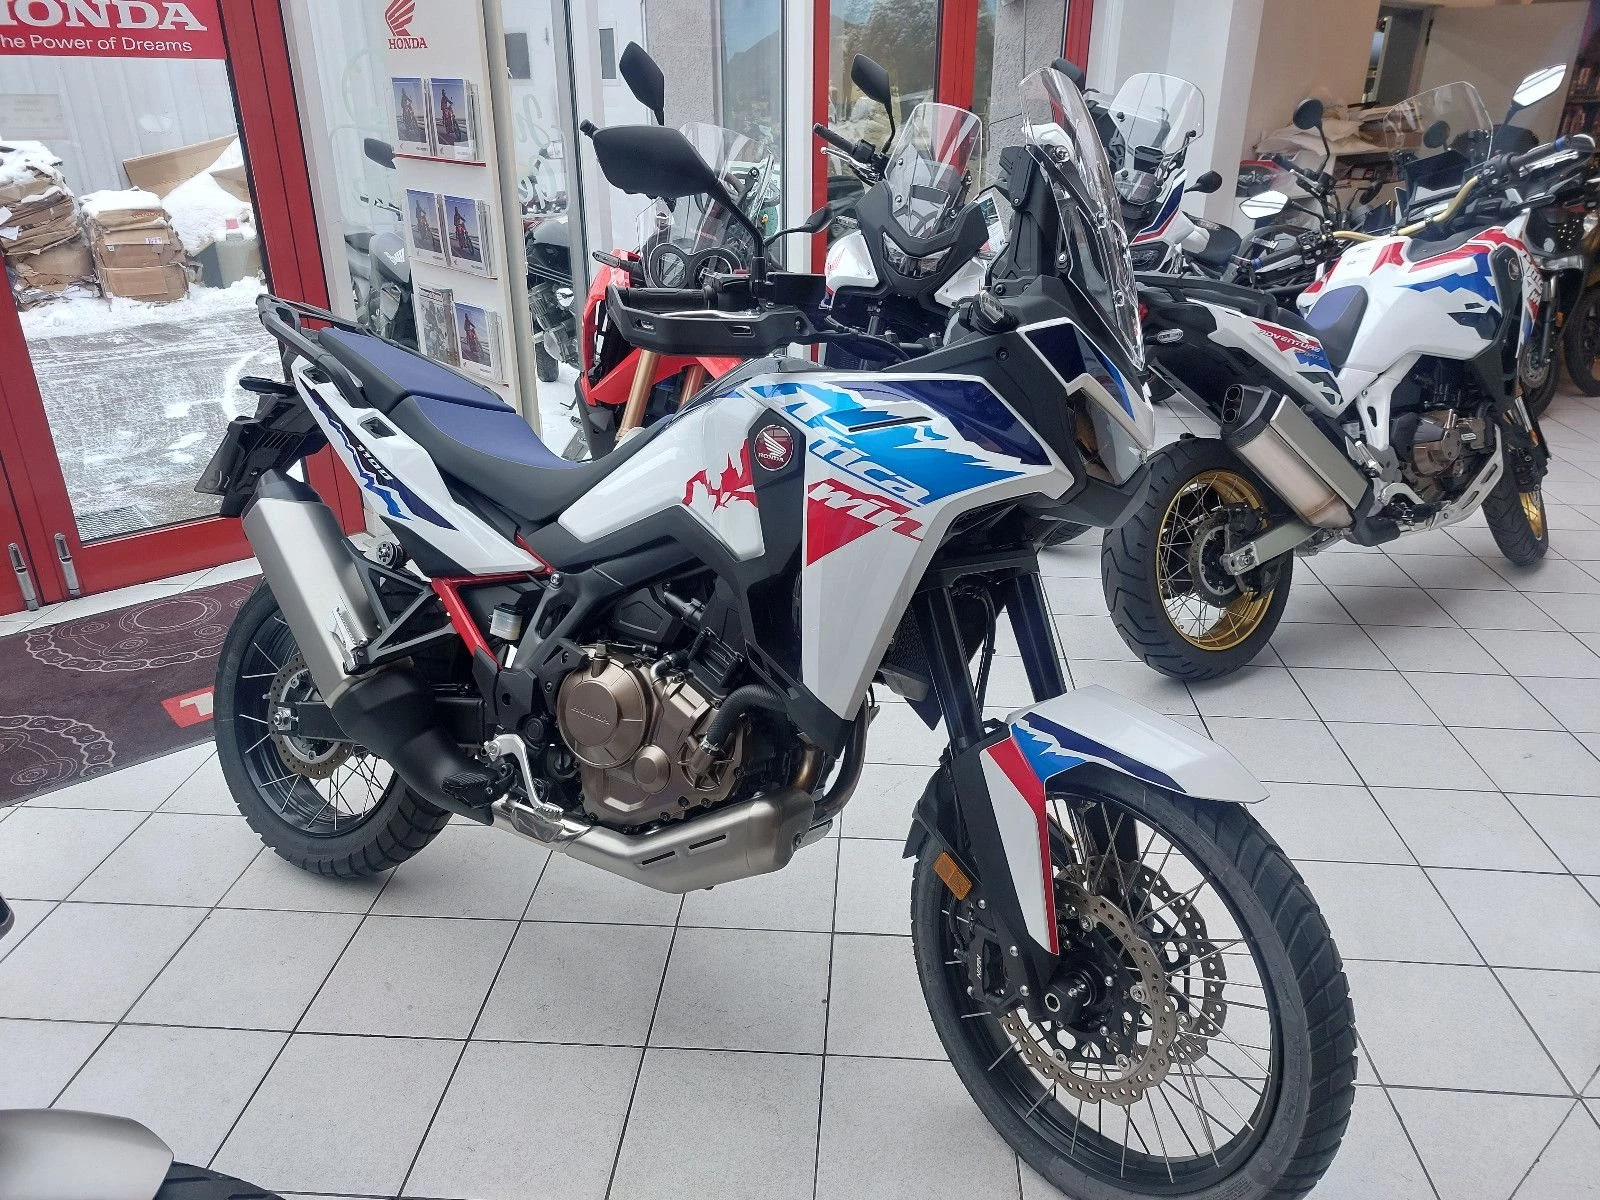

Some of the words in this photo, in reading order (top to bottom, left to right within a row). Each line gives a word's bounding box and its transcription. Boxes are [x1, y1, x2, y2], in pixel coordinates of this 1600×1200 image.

[0, 34, 26, 48] he
[29, 34, 93, 50] Power
[97, 36, 116, 50] of
[122, 37, 193, 52] Dreams
[388, 37, 428, 50] HONDA
[356, 444, 394, 481] 1100
